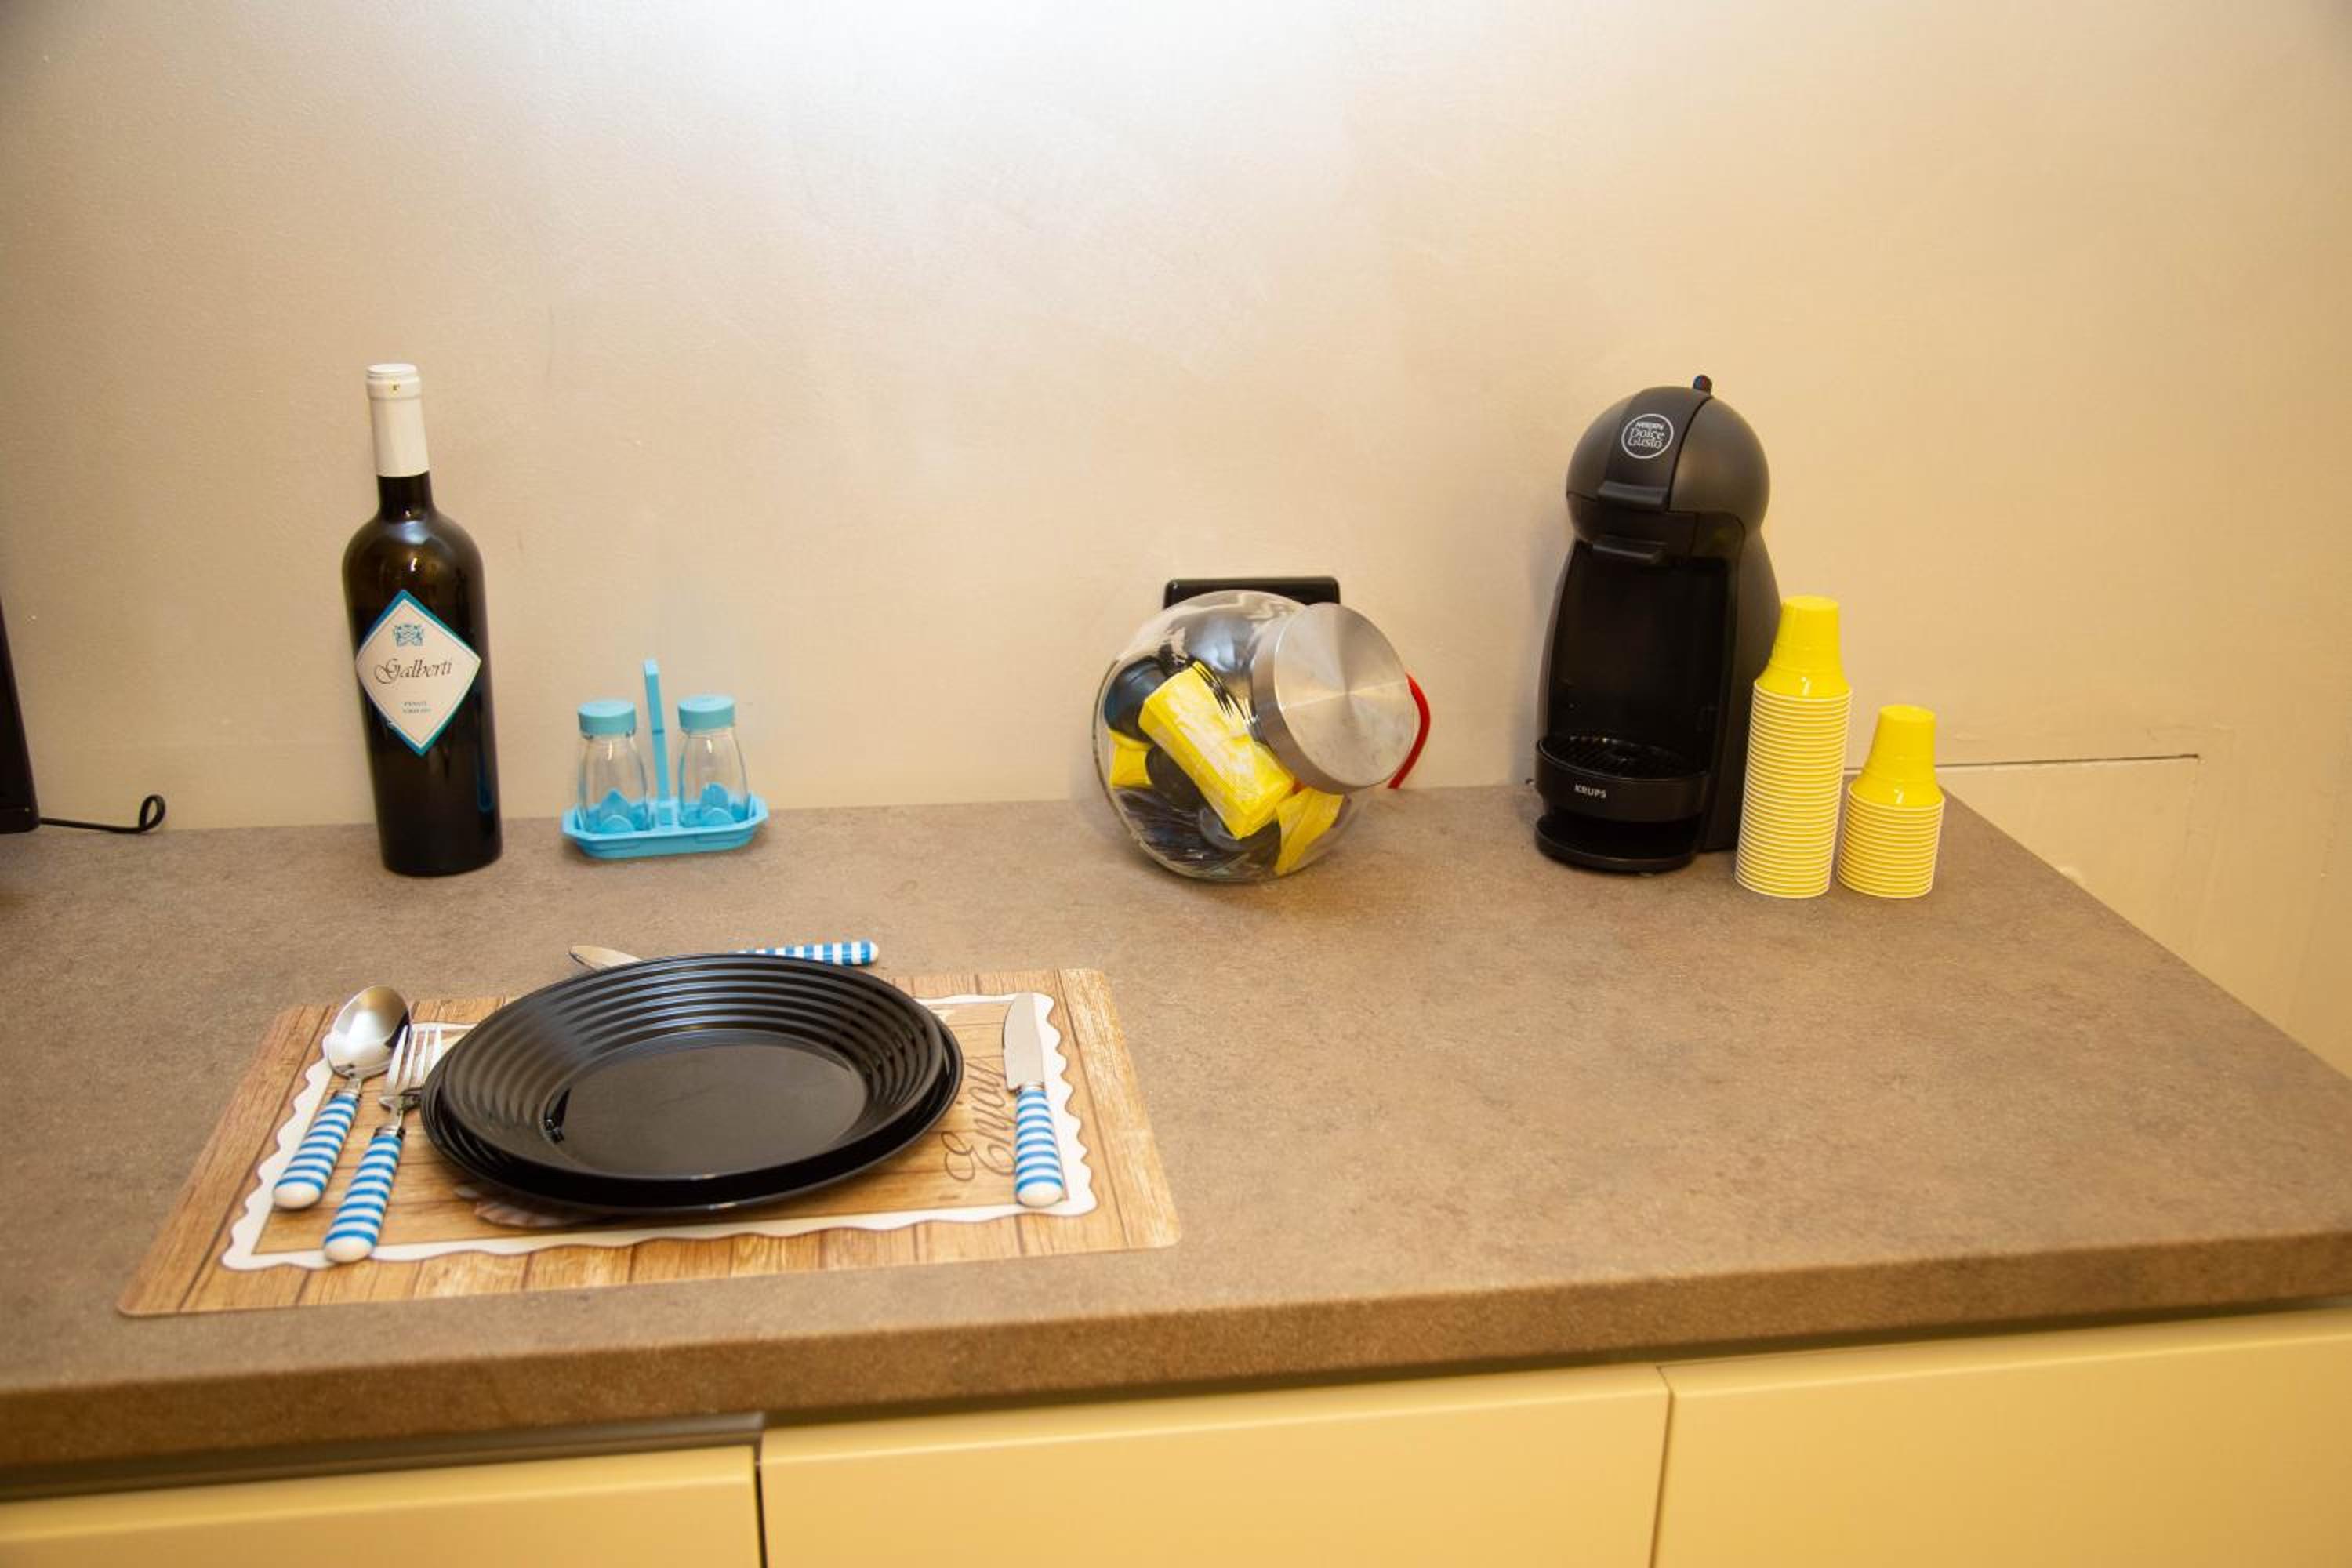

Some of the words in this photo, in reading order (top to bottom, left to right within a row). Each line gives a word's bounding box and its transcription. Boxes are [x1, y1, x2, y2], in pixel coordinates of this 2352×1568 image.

[1631, 427, 1665, 440] Dolce
[1628, 437, 1663, 449] Gusto
[374, 658, 452, 684] Galberti
[1574, 783, 1606, 799] KRUPS
